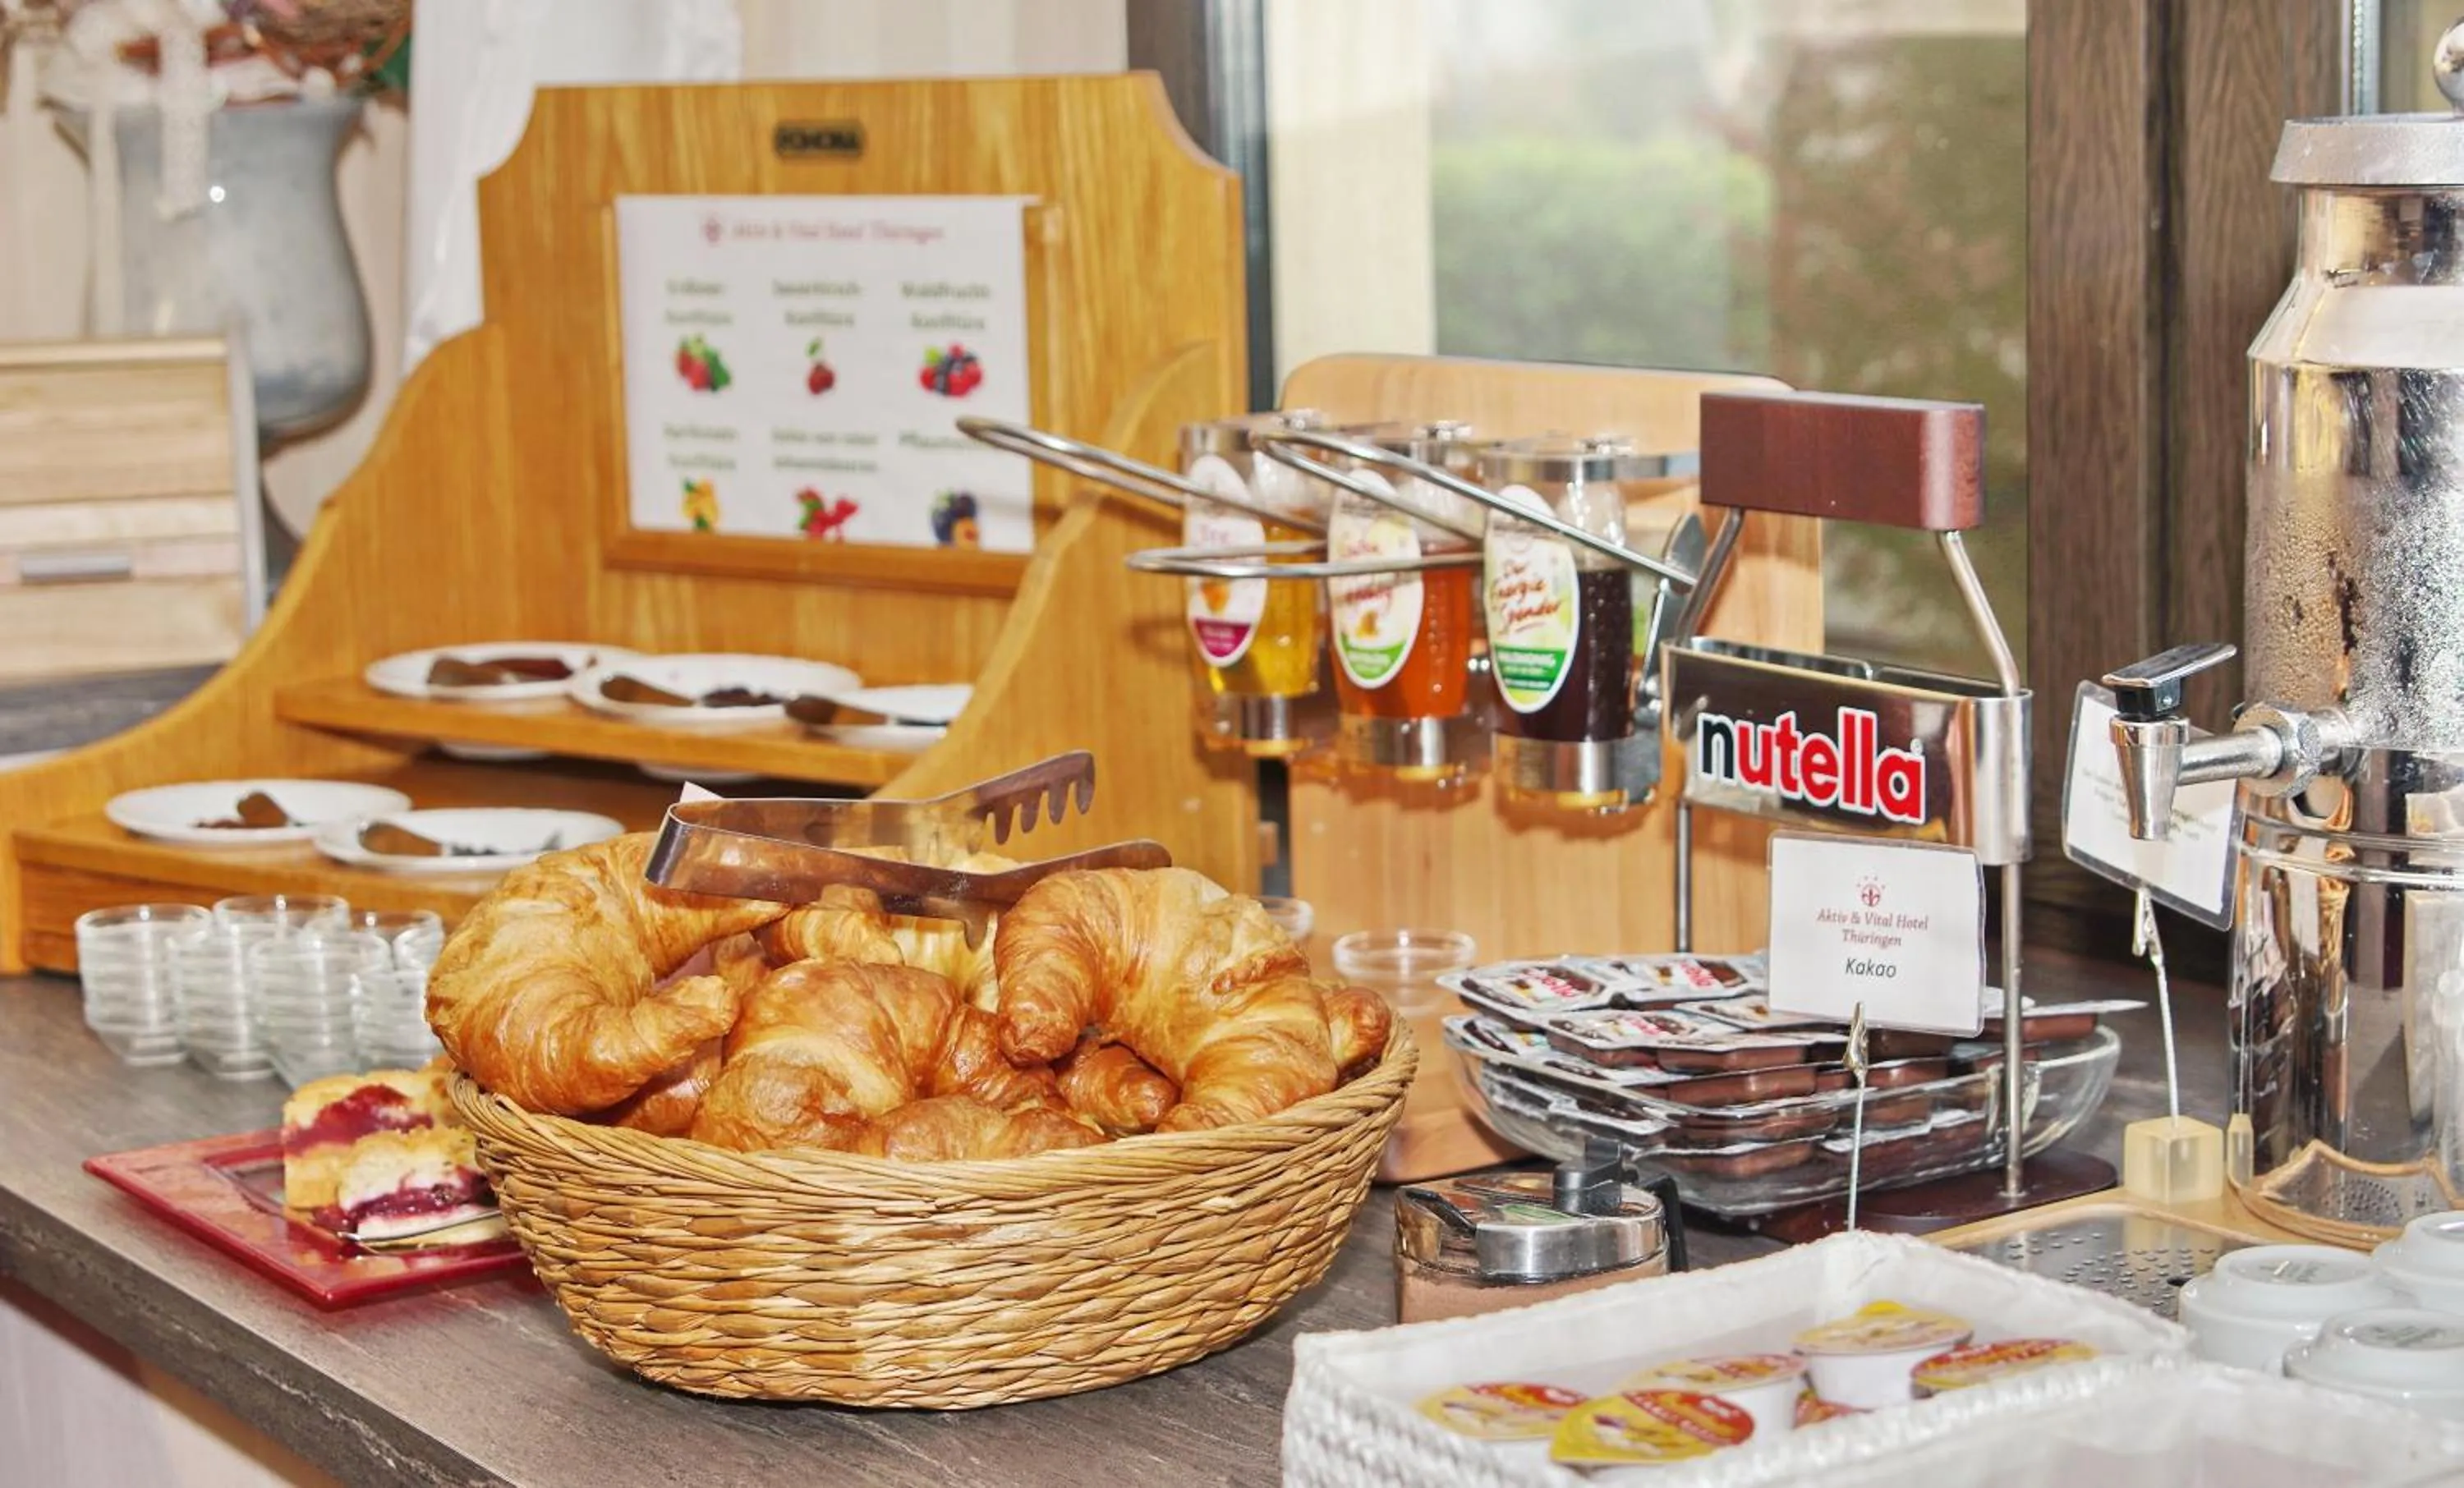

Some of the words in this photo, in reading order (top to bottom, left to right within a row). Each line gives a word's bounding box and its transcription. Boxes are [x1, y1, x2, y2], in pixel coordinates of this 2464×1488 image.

[1698, 706, 1924, 824] nutella
[1816, 907, 1849, 924] Aktiv
[1851, 911, 1861, 925] &
[1864, 912, 1893, 928] Vital
[1896, 913, 1928, 930] Hotel
[1845, 957, 1897, 978] Kakao
